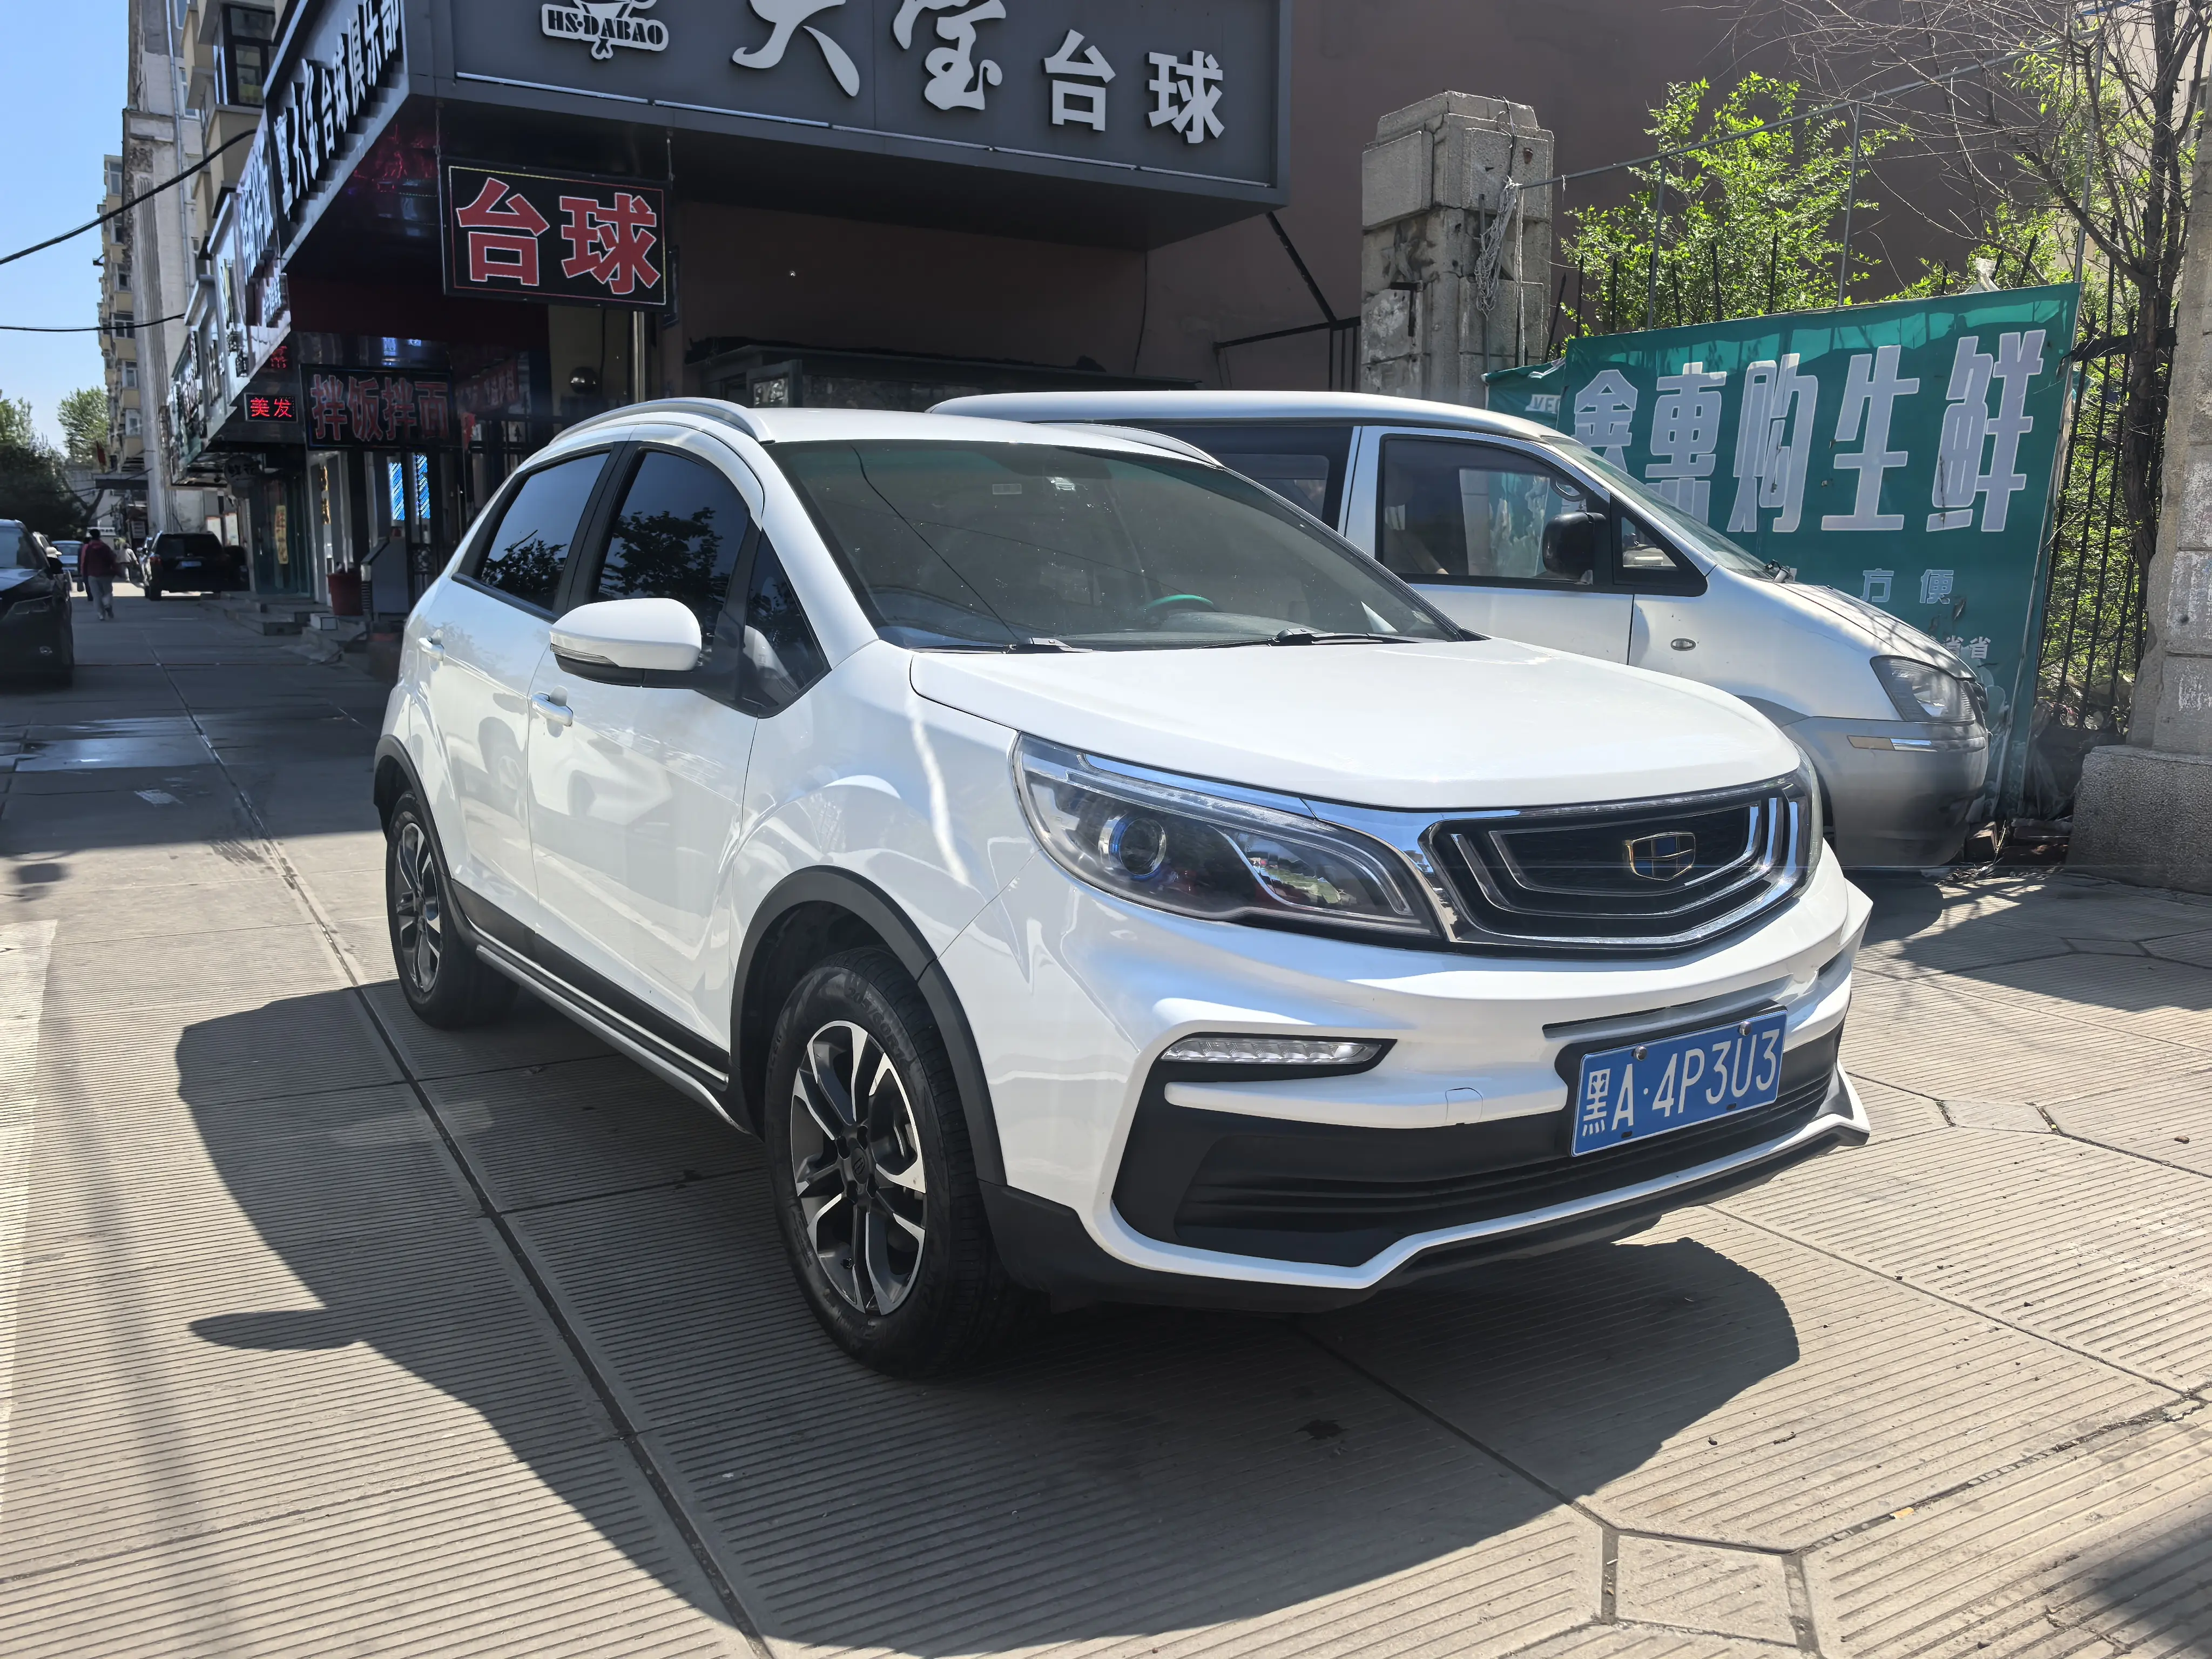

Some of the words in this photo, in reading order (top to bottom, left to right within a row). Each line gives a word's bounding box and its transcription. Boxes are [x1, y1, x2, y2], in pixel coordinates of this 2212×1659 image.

[456, 178, 660, 295] 台球
[250, 397, 292, 417] 美发
[310, 374, 449, 442] 拌饭拌面
[1860, 569, 1954, 604] 方便
[1582, 1028, 1780, 1137] 黑A·4P3U3
